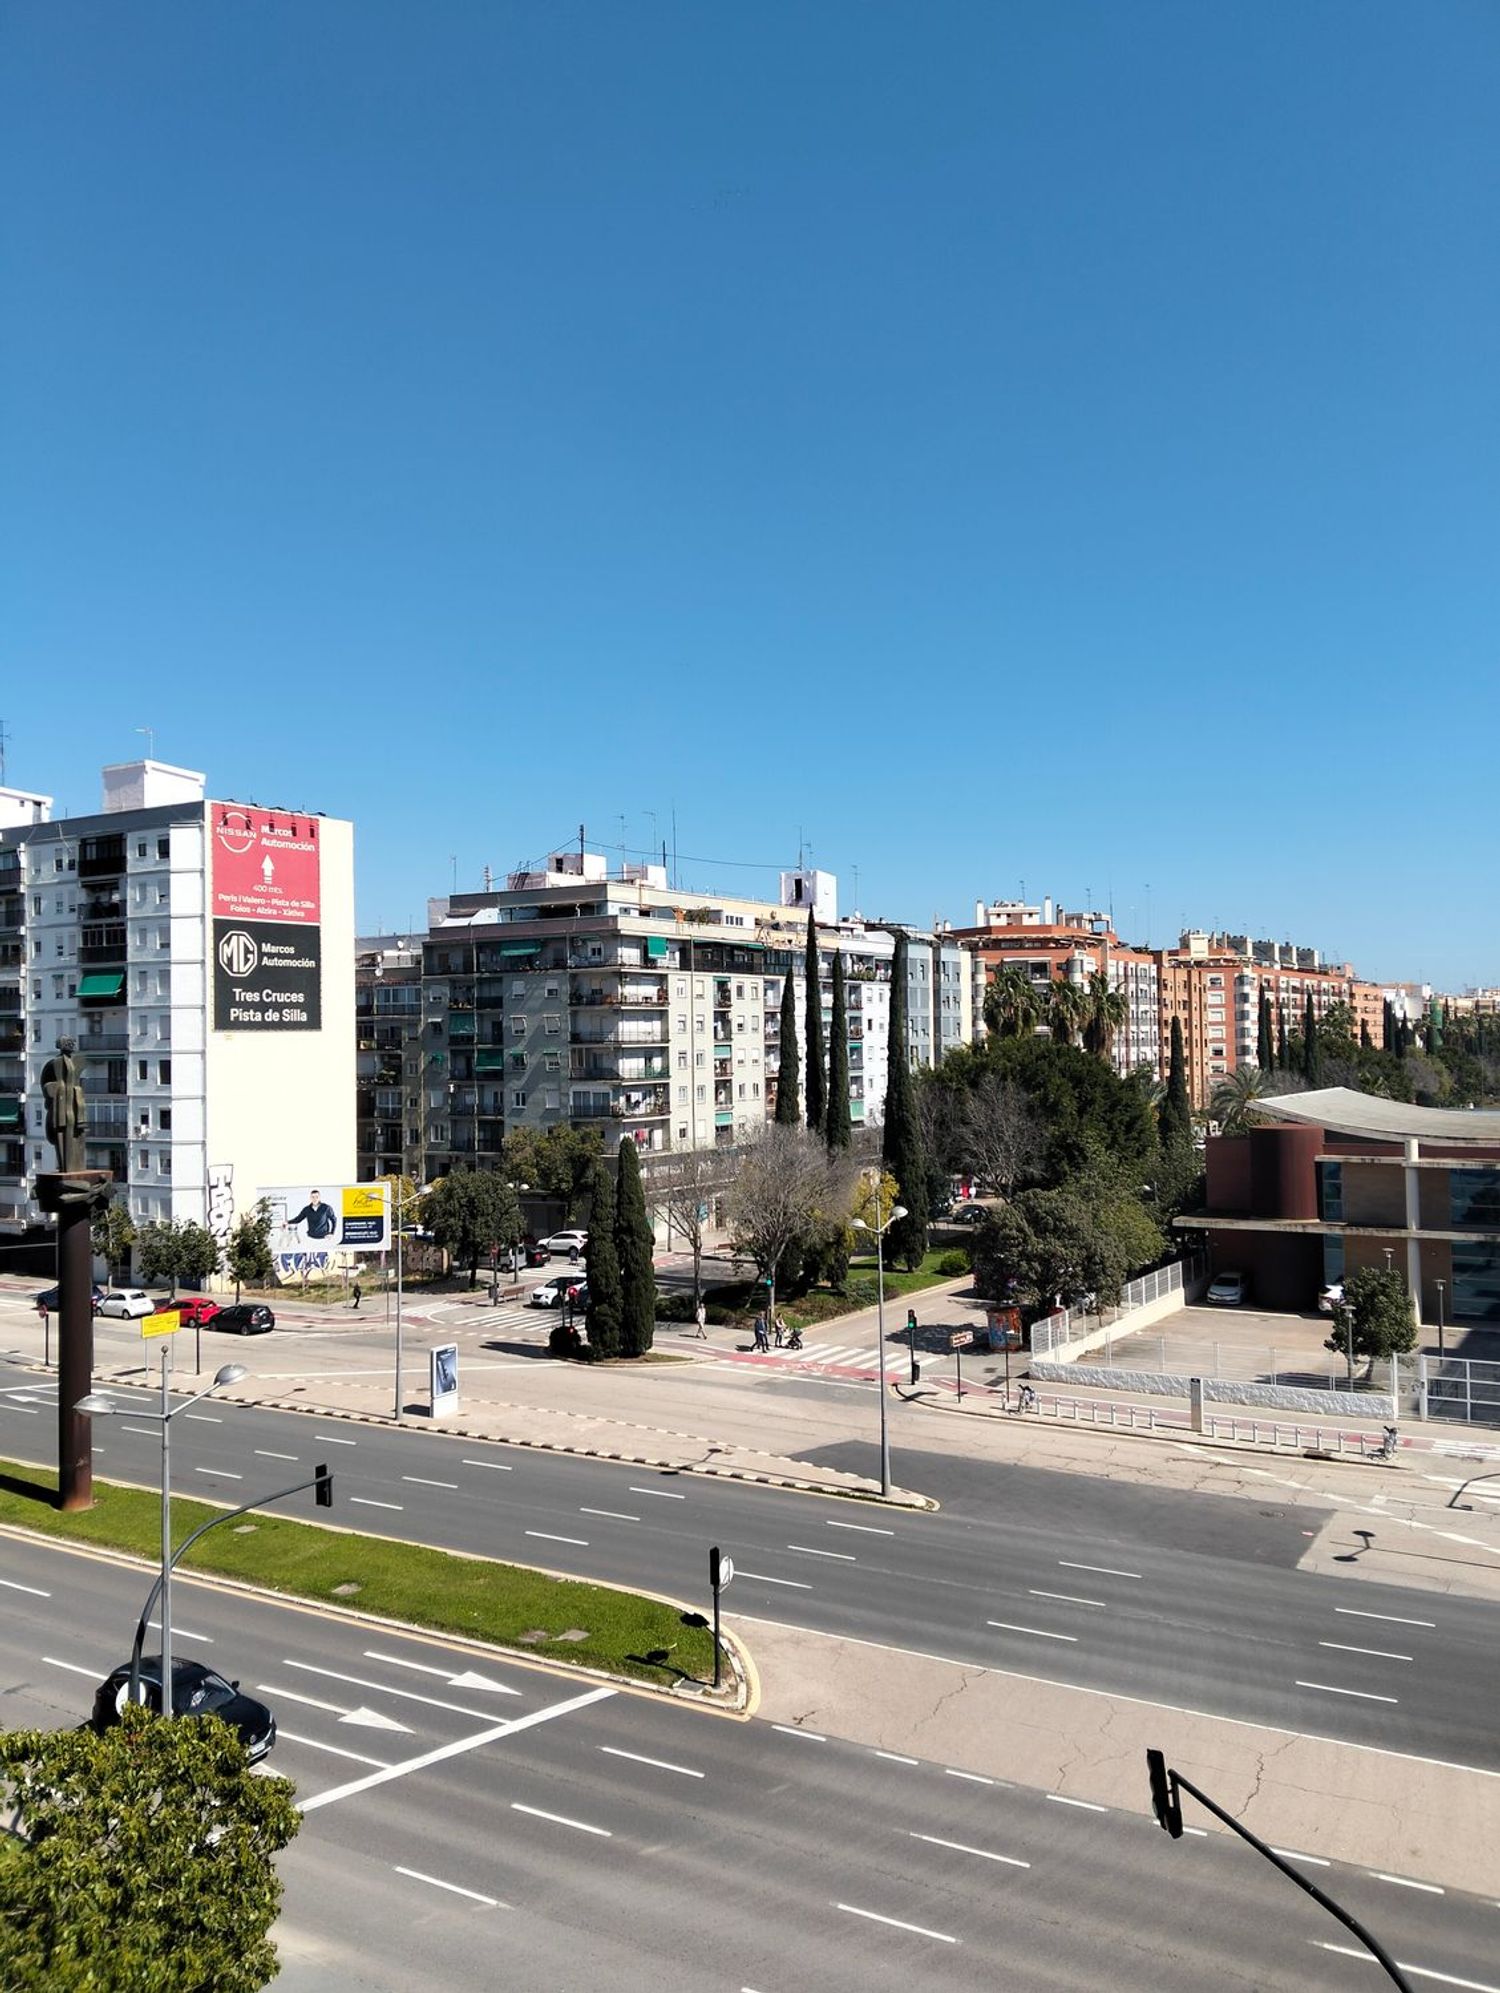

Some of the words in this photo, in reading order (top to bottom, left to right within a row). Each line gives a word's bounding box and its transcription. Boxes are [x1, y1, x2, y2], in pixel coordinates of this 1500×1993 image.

[216, 826, 257, 839] NISSAN
[261, 838, 315, 852] Automoción
[290, 900, 300, 908] de
[222, 934, 255, 974] MG
[261, 942, 295, 954] Marcos
[261, 956, 315, 968] Automoción
[232, 988, 260, 1002] Tres
[262, 988, 305, 1003] Cruces
[230, 1008, 262, 1022] Pista
[264, 1008, 280, 1022] de
[282, 1008, 307, 1022] Silla
